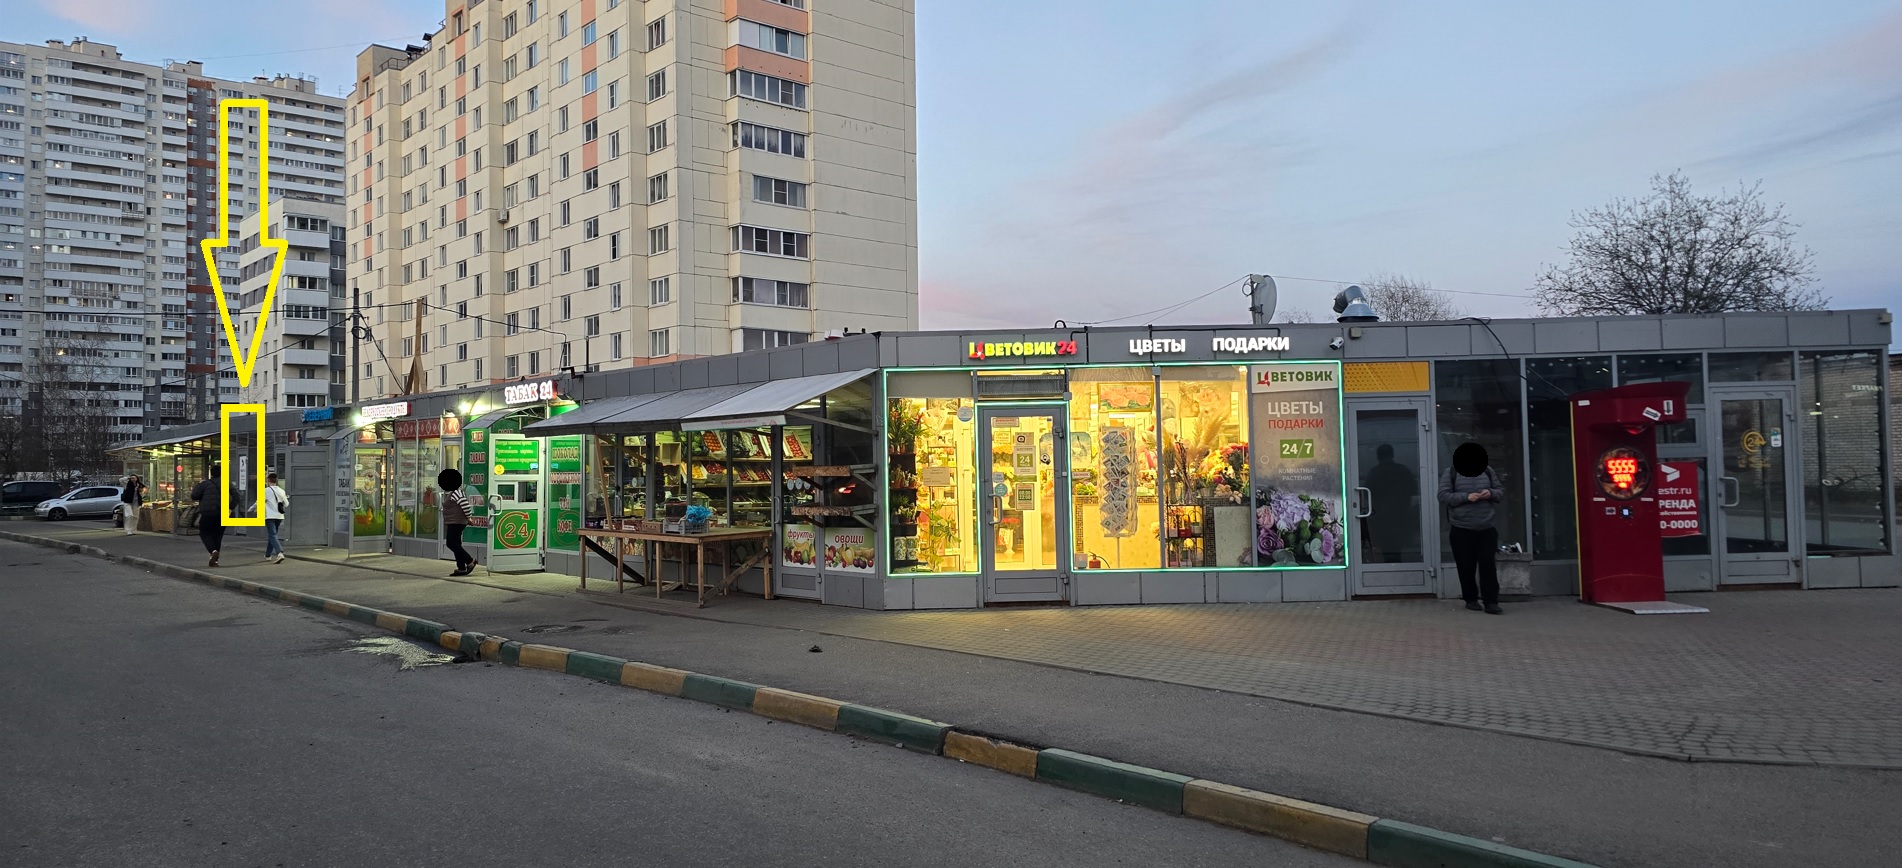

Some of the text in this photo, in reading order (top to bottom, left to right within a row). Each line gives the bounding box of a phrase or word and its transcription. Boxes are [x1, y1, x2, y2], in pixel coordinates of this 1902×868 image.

[969, 340, 1077, 360] ЦВЕТОВИК 24
[1129, 339, 1186, 355] ЦВЕТЫ
[1212, 337, 1290, 353] ПОДАРКИ
[1257, 370, 1332, 387] ЦВЕТОВИК
[505, 380, 553, 404] ТАБАК 24
[1268, 401, 1323, 417] ЦВЕТЫ
[1268, 419, 1324, 430] ПОДАРКИ
[1282, 443, 1313, 455] 24/7
[1658, 499, 1696, 510] РЕНДА
[505, 523, 528, 538] 24
[1659, 520, 1698, 529] 0-0000
[787, 529, 815, 540] фрукты
[834, 534, 864, 545] овощи
